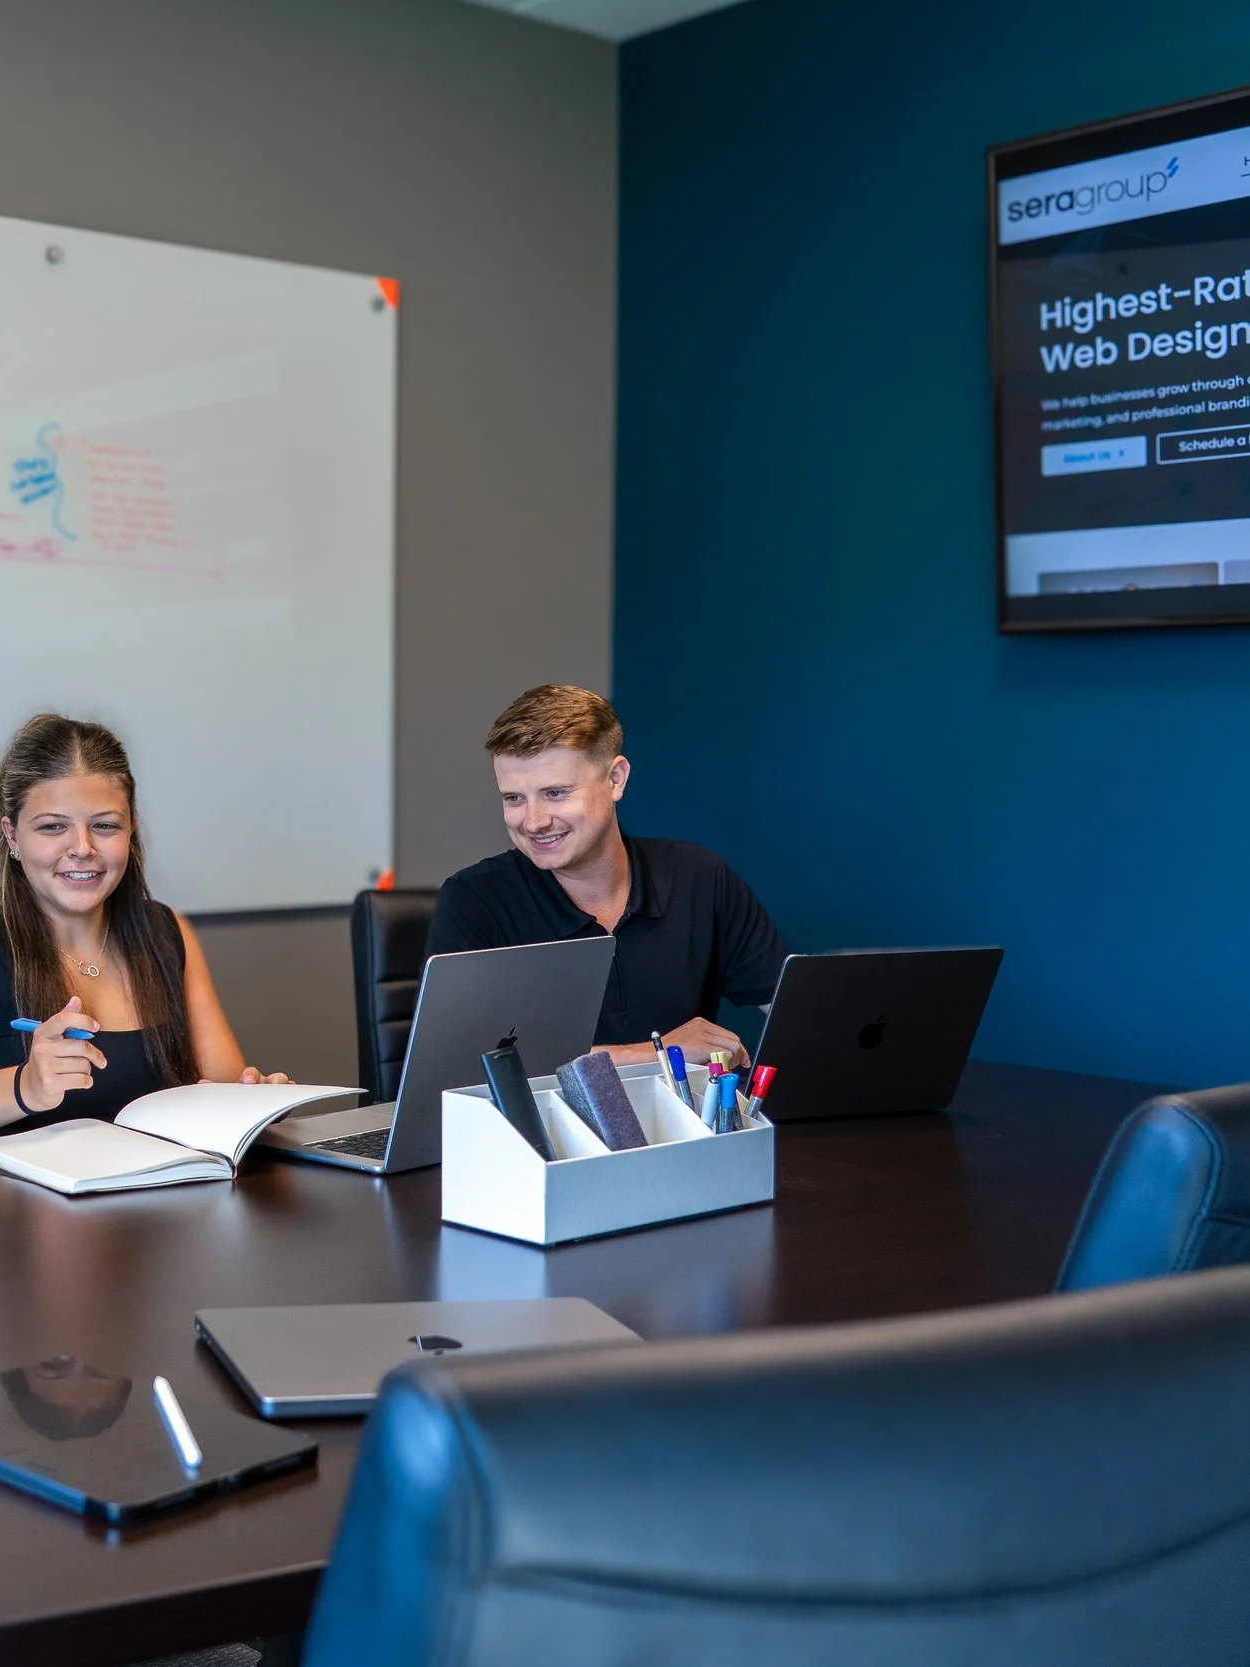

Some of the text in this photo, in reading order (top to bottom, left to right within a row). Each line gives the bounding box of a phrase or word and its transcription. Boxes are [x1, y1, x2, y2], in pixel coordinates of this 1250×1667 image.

[1007, 171, 1168, 223] seragroup
[1040, 320, 1250, 374] Web Design
[1090, 387, 1155, 406] businesses
[1157, 383, 1190, 398] grow
[1191, 374, 1244, 392] through
[1106, 410, 1130, 425] and
[1131, 400, 1206, 424] professional
[1179, 435, 1235, 453] Schedule
[1236, 436, 1247, 446] a
